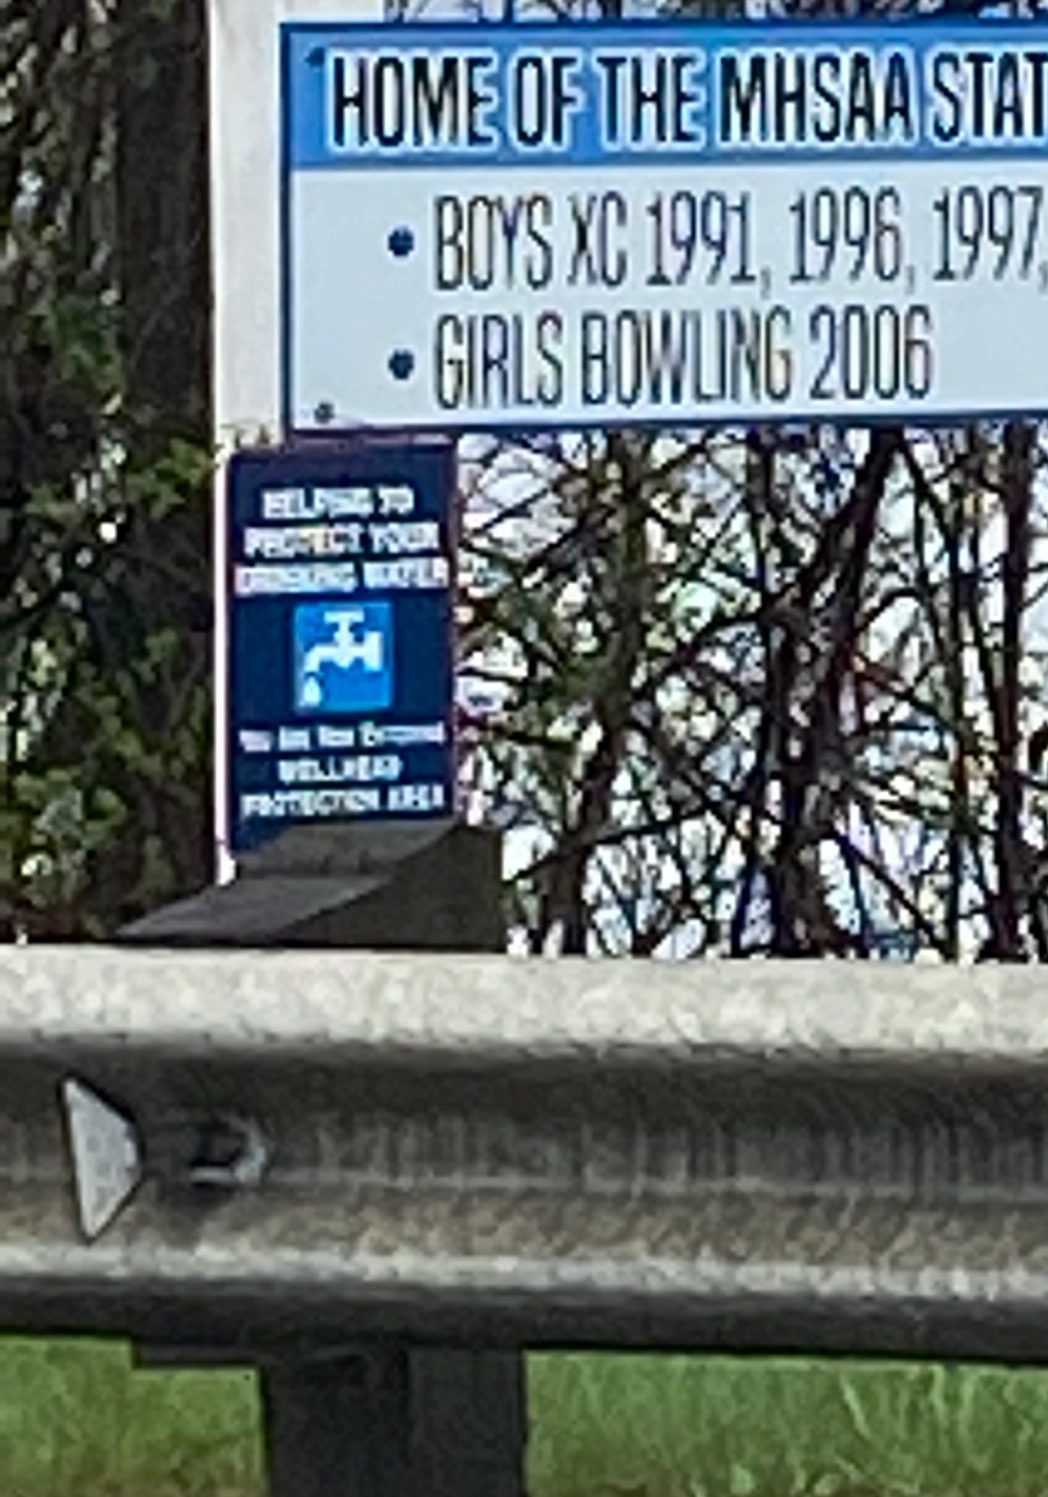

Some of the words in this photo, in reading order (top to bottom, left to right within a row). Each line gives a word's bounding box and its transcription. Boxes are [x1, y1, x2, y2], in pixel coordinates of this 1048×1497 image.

[332, 55, 493, 147] HOME
[514, 53, 579, 146] OF
[599, 53, 701, 144] THE
[717, 51, 914, 144] MHSAA
[434, 193, 552, 291] BOYS
[567, 190, 627, 288] XC
[644, 188, 772, 297] 1991,
[788, 186, 917, 292] 1996,
[434, 313, 563, 410] GIRLS
[580, 308, 792, 405] BOWLING
[808, 304, 932, 400] 2006
[244, 526, 363, 556] PROTECT
